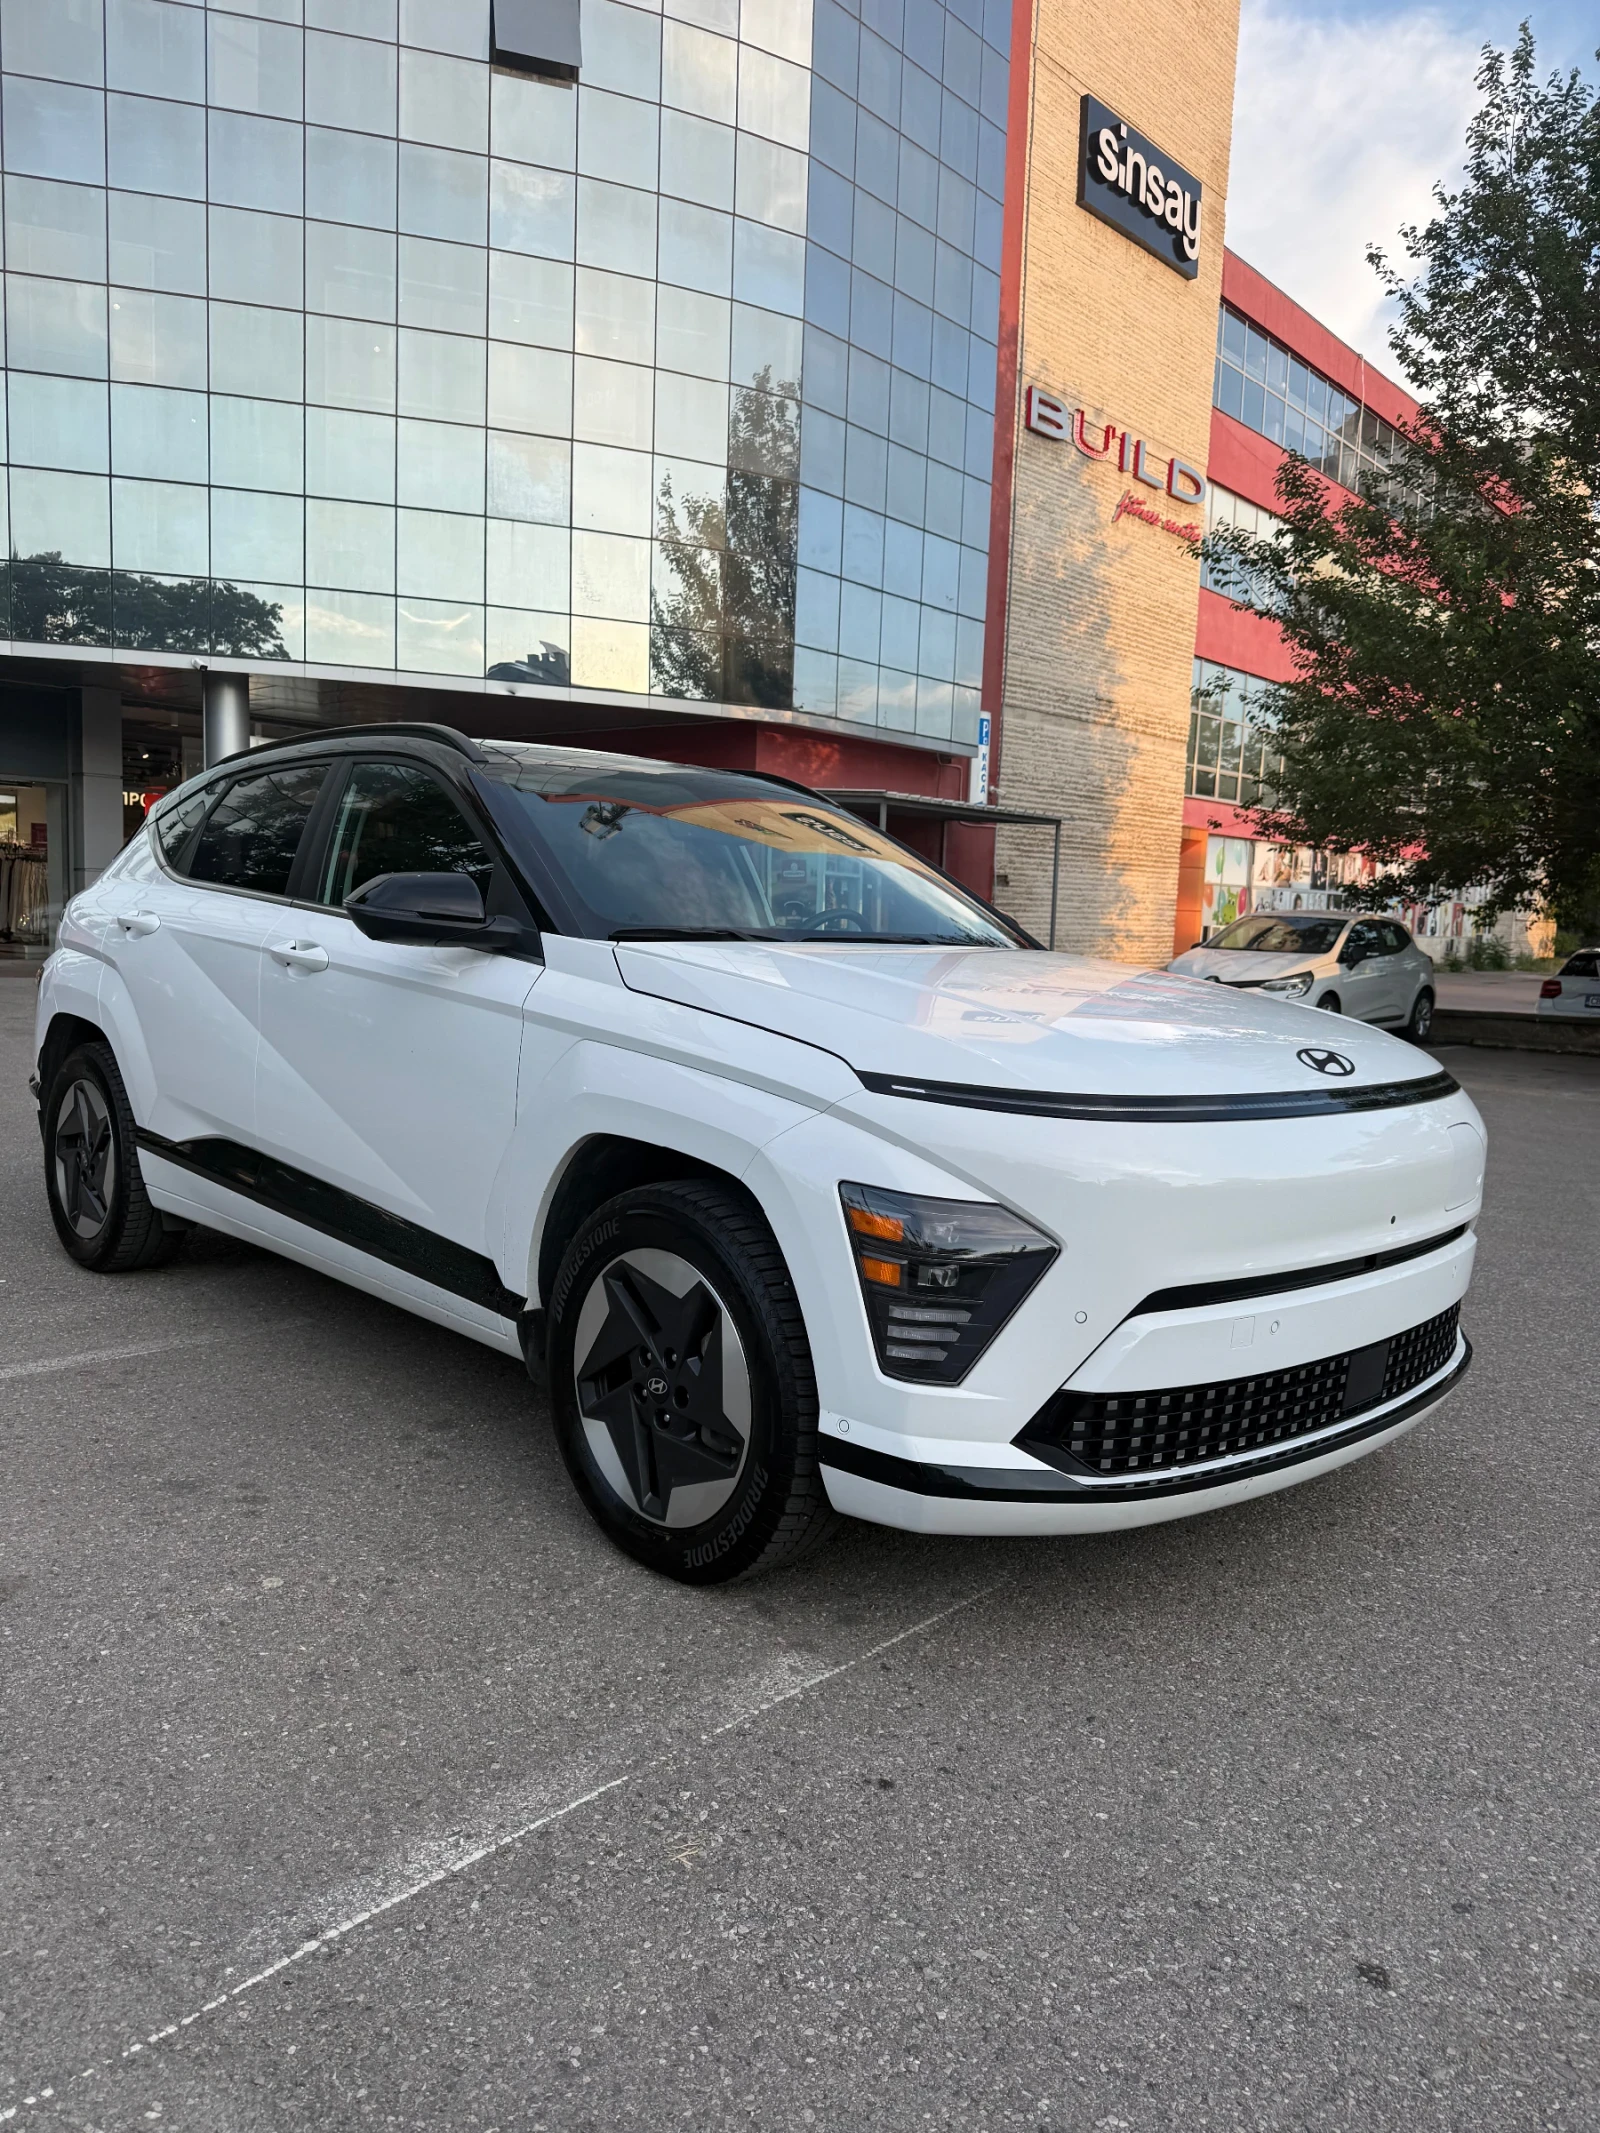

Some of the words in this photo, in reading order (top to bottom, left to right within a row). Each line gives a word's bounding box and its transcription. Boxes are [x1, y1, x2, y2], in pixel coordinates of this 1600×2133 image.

[1097, 123, 1202, 261] sinsay
[1025, 385, 1206, 504] BUILD
[982, 721, 989, 737] P
[553, 1216, 620, 1324] BRIDGESTONE
[683, 1462, 768, 1569] BRIDGESTONE
